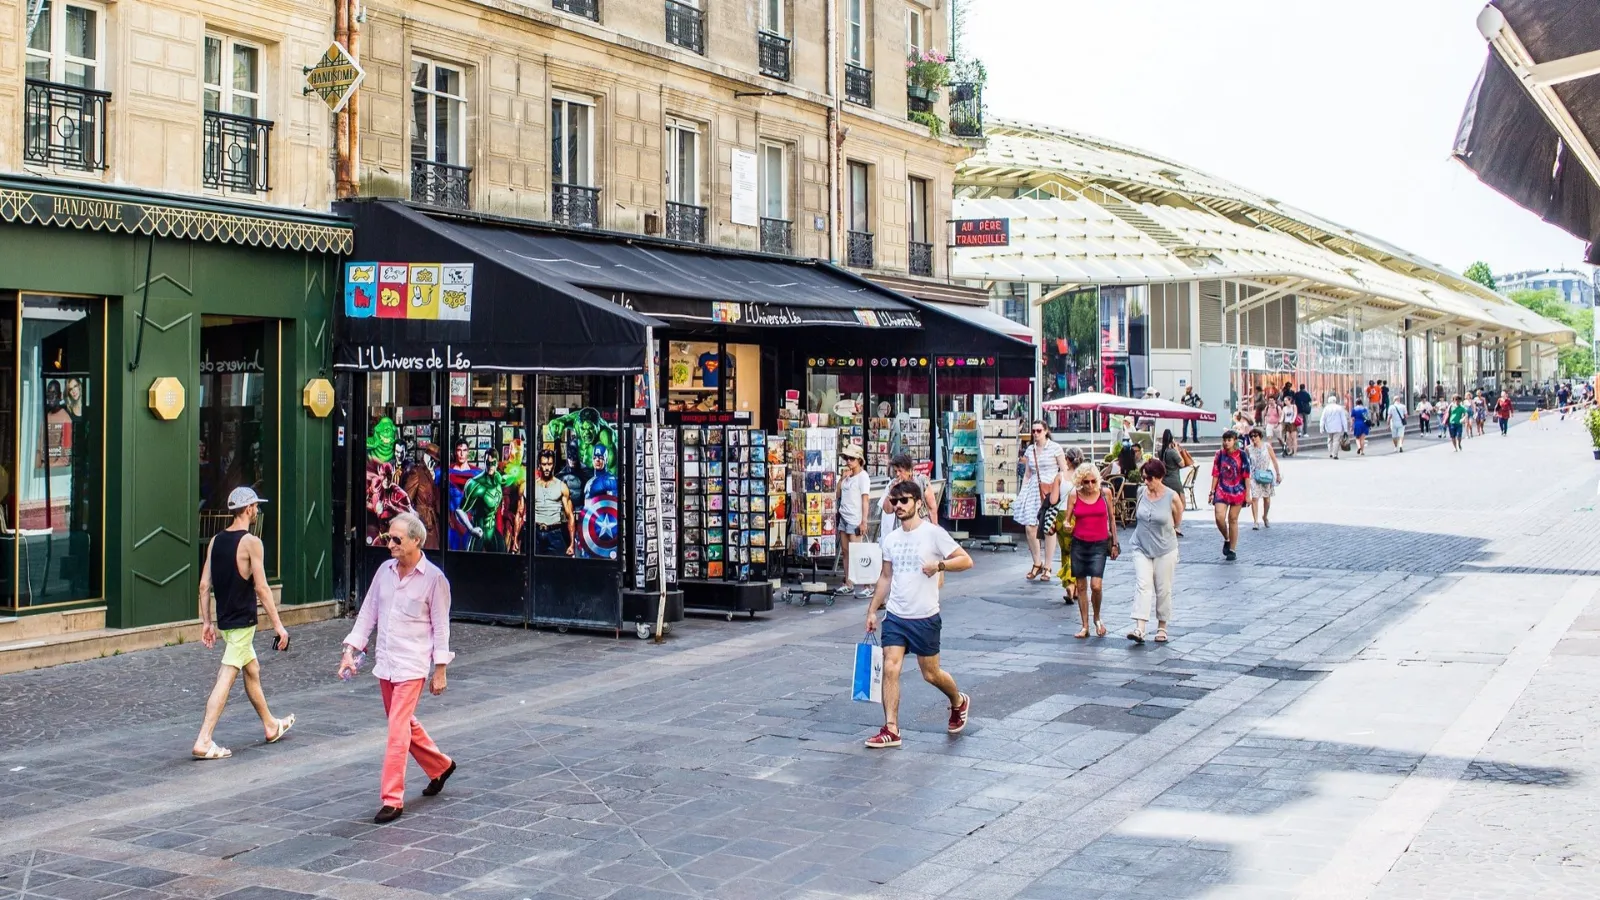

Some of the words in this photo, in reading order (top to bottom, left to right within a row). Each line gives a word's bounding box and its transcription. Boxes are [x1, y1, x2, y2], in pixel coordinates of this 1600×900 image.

[311, 69, 354, 84] HANDSOME
[54, 197, 123, 220] HANDSOME
[961, 222, 974, 231] AU
[956, 233, 1007, 244] TRANQUILLE
[745, 302, 779, 325] L'Univers
[779, 308, 789, 325] de
[358, 345, 423, 370] L'Univers
[426, 348, 443, 368] de
[447, 345, 470, 370] Léo
